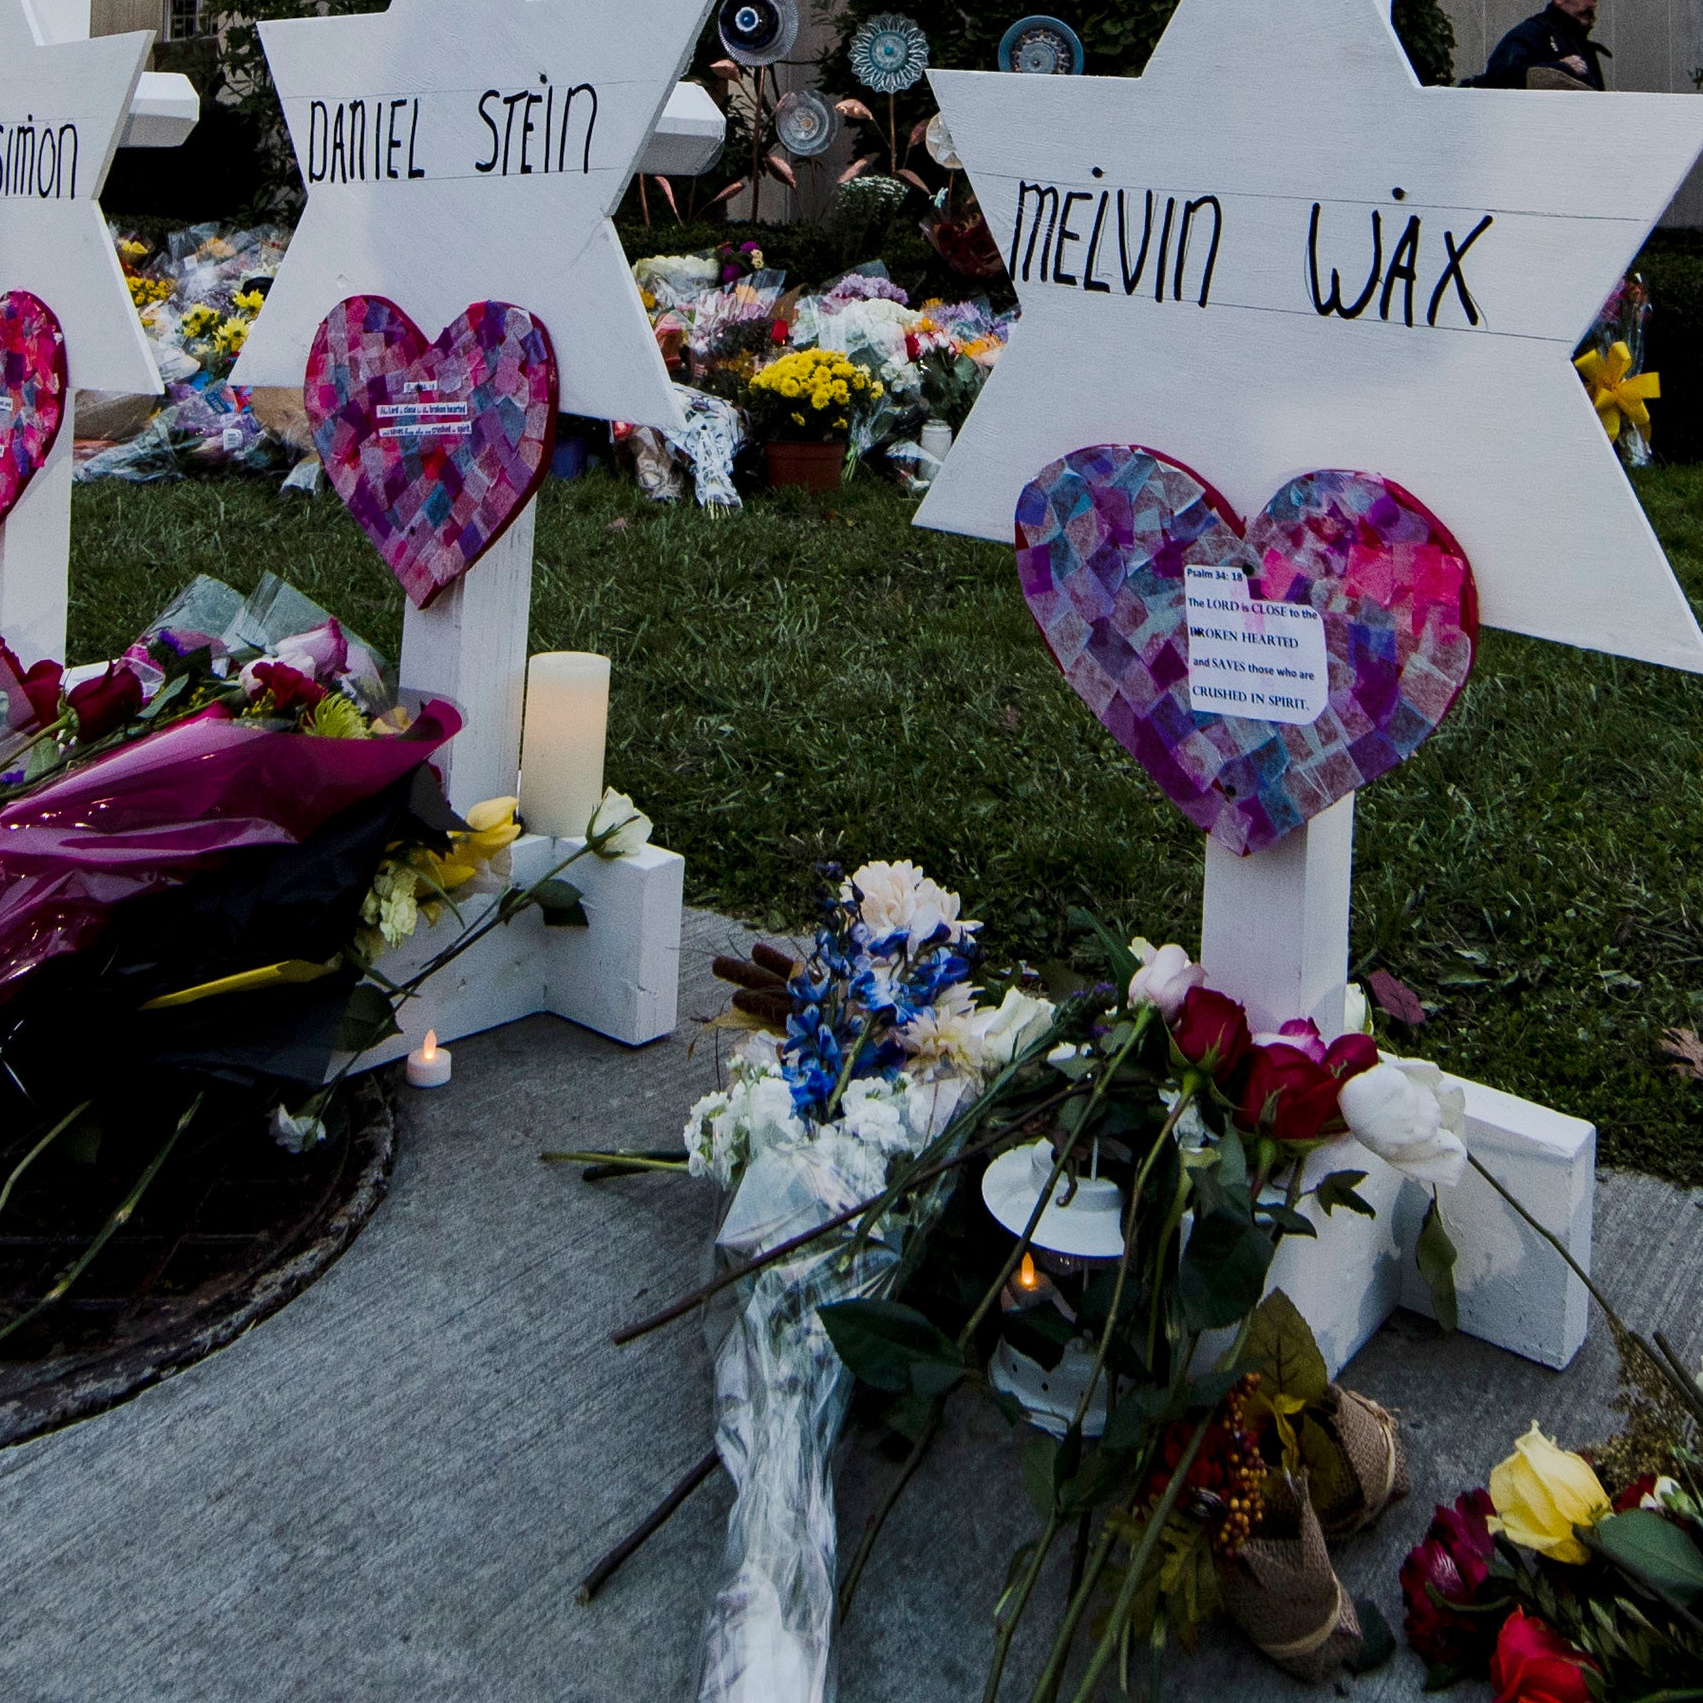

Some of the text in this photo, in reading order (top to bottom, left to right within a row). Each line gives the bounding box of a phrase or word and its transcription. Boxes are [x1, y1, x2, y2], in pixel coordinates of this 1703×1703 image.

[308, 82, 599, 183] DANIEL STEIN
[1009, 180, 1495, 328] MELVIN WAX
[1187, 568, 1243, 582] Psalm 34: 18
[1188, 597, 1317, 620] The LORD is CLOSE to the
[1190, 626, 1298, 648] BROKEN HEARTED
[1193, 658, 1315, 681] and SAVES those who are
[1192, 685, 1310, 711] CRUSHED IN SPIRIT.
